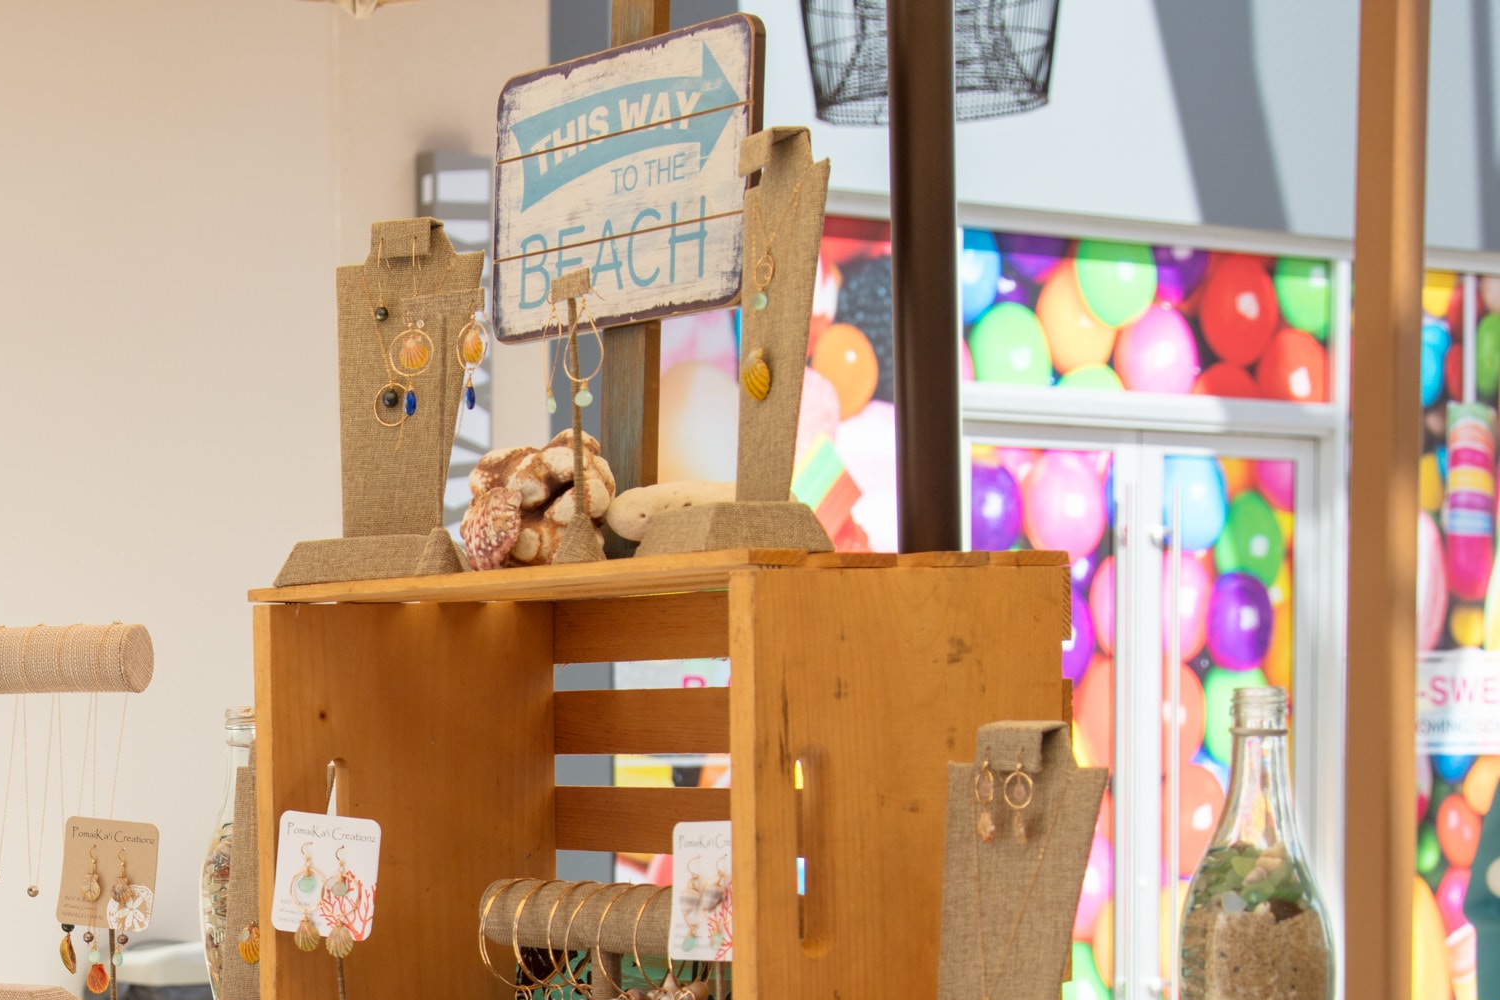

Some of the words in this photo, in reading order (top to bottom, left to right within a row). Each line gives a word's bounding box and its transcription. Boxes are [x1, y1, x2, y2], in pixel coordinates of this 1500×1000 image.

[530, 105, 609, 176] THIS
[617, 90, 702, 133] WAY
[610, 166, 639, 195] TO
[644, 152, 687, 187] THE
[520, 196, 706, 309] BEACH
[114, 830, 156, 845] Creationz
[332, 827, 376, 843] Creationz
